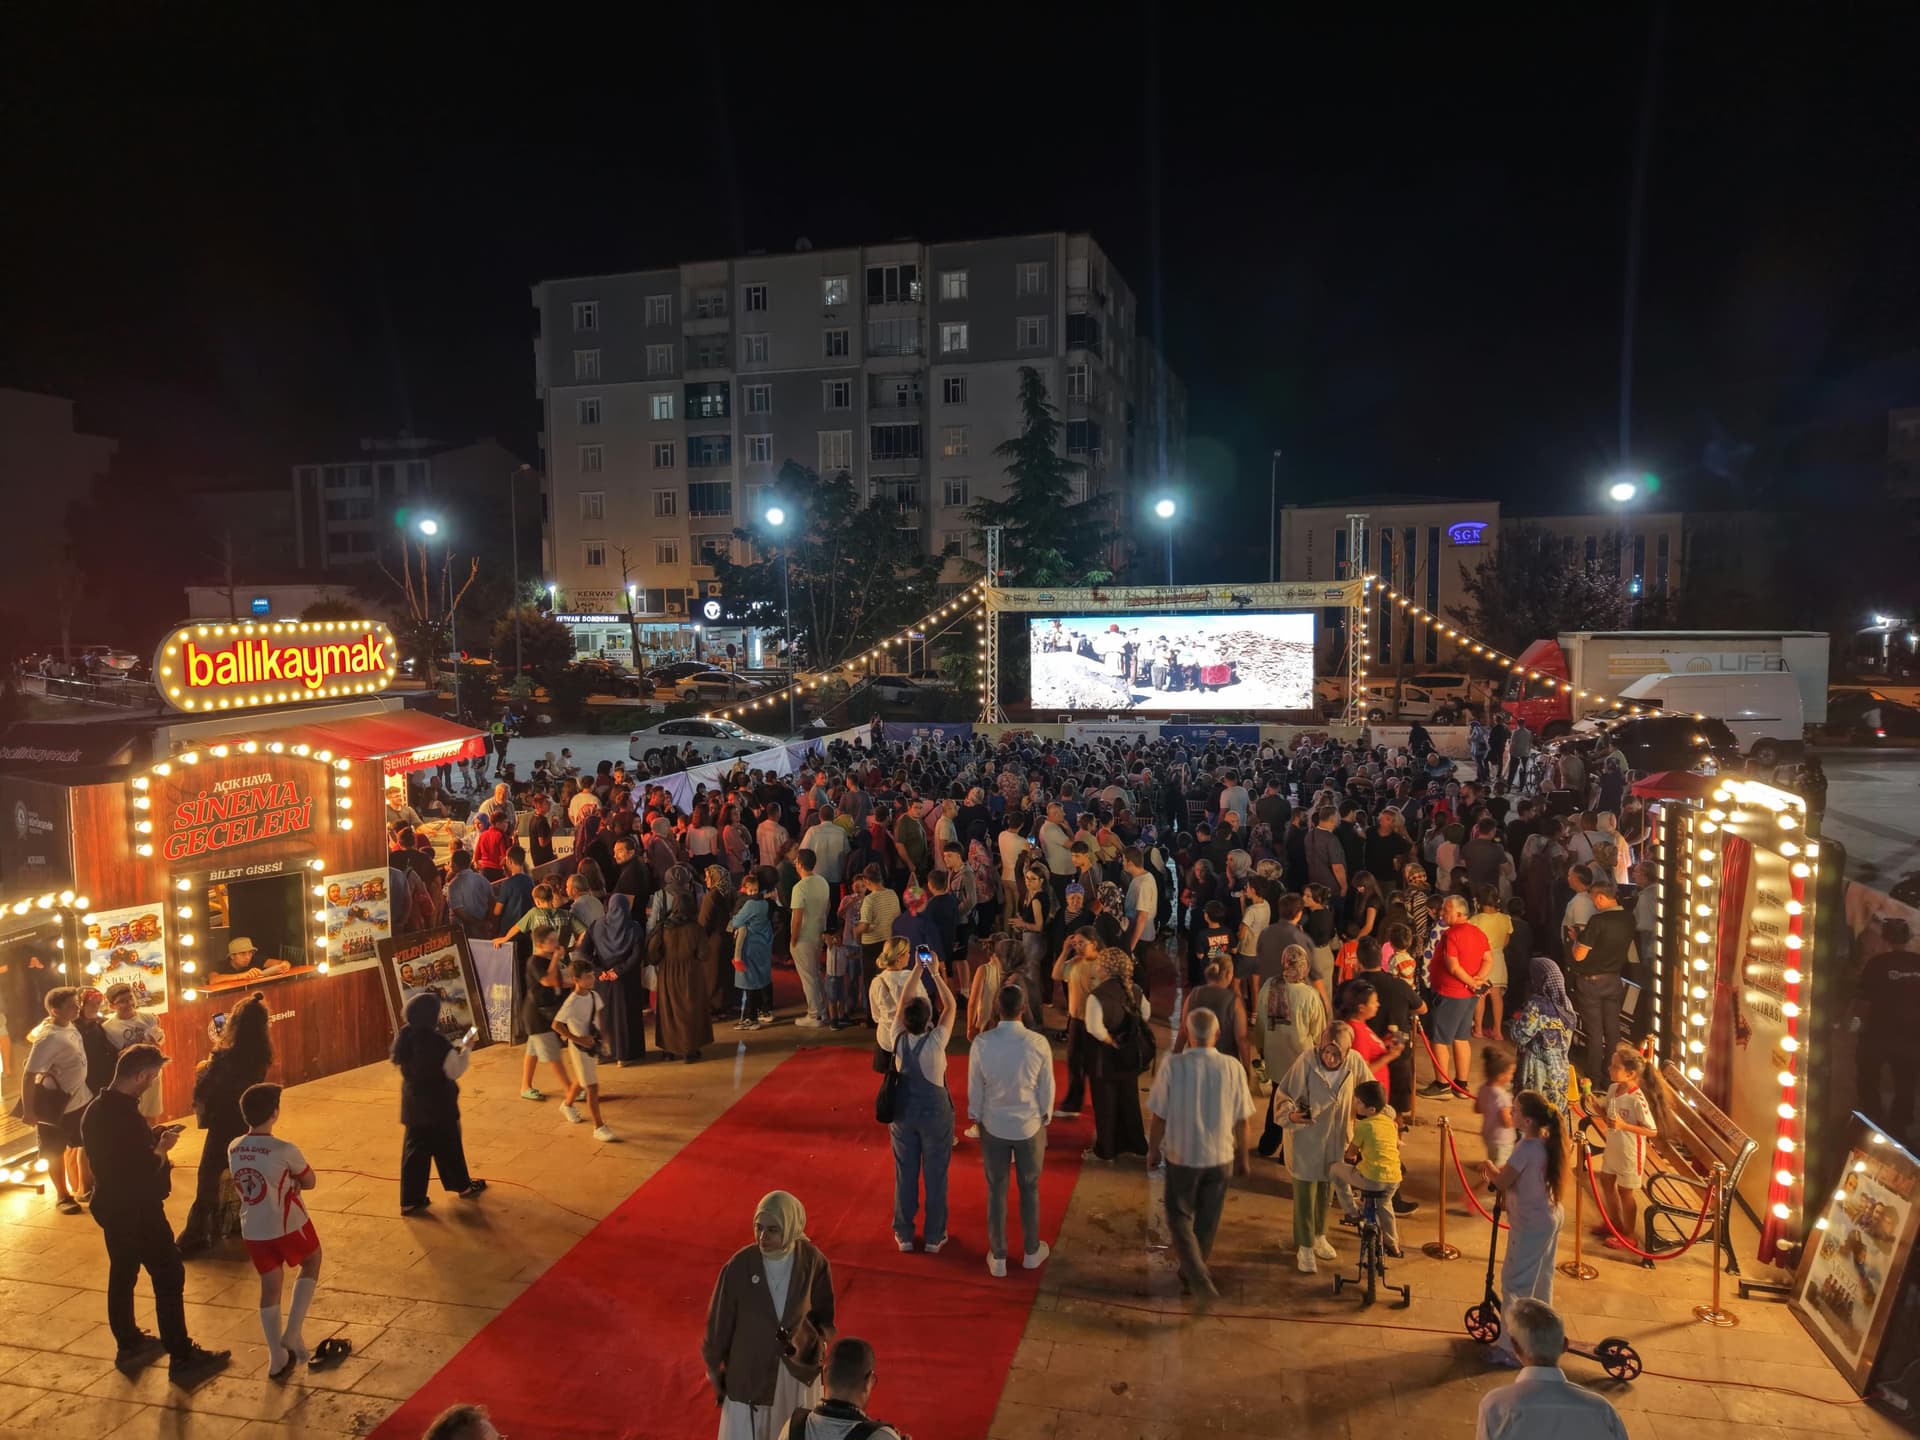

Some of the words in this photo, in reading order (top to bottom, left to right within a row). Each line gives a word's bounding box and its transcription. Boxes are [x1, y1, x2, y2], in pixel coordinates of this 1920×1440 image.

[1454, 530, 1481, 541] SGK
[556, 615, 580, 623] KERVAN
[582, 615, 619, 623] DONDURMA
[184, 634, 386, 690] ballıkaymak
[213, 779, 241, 794] AÇIK
[241, 773, 272, 787] HAVA
[174, 780, 300, 831] SİNEMA
[163, 795, 313, 861] GECELERİ
[209, 868, 243, 881] BİLET
